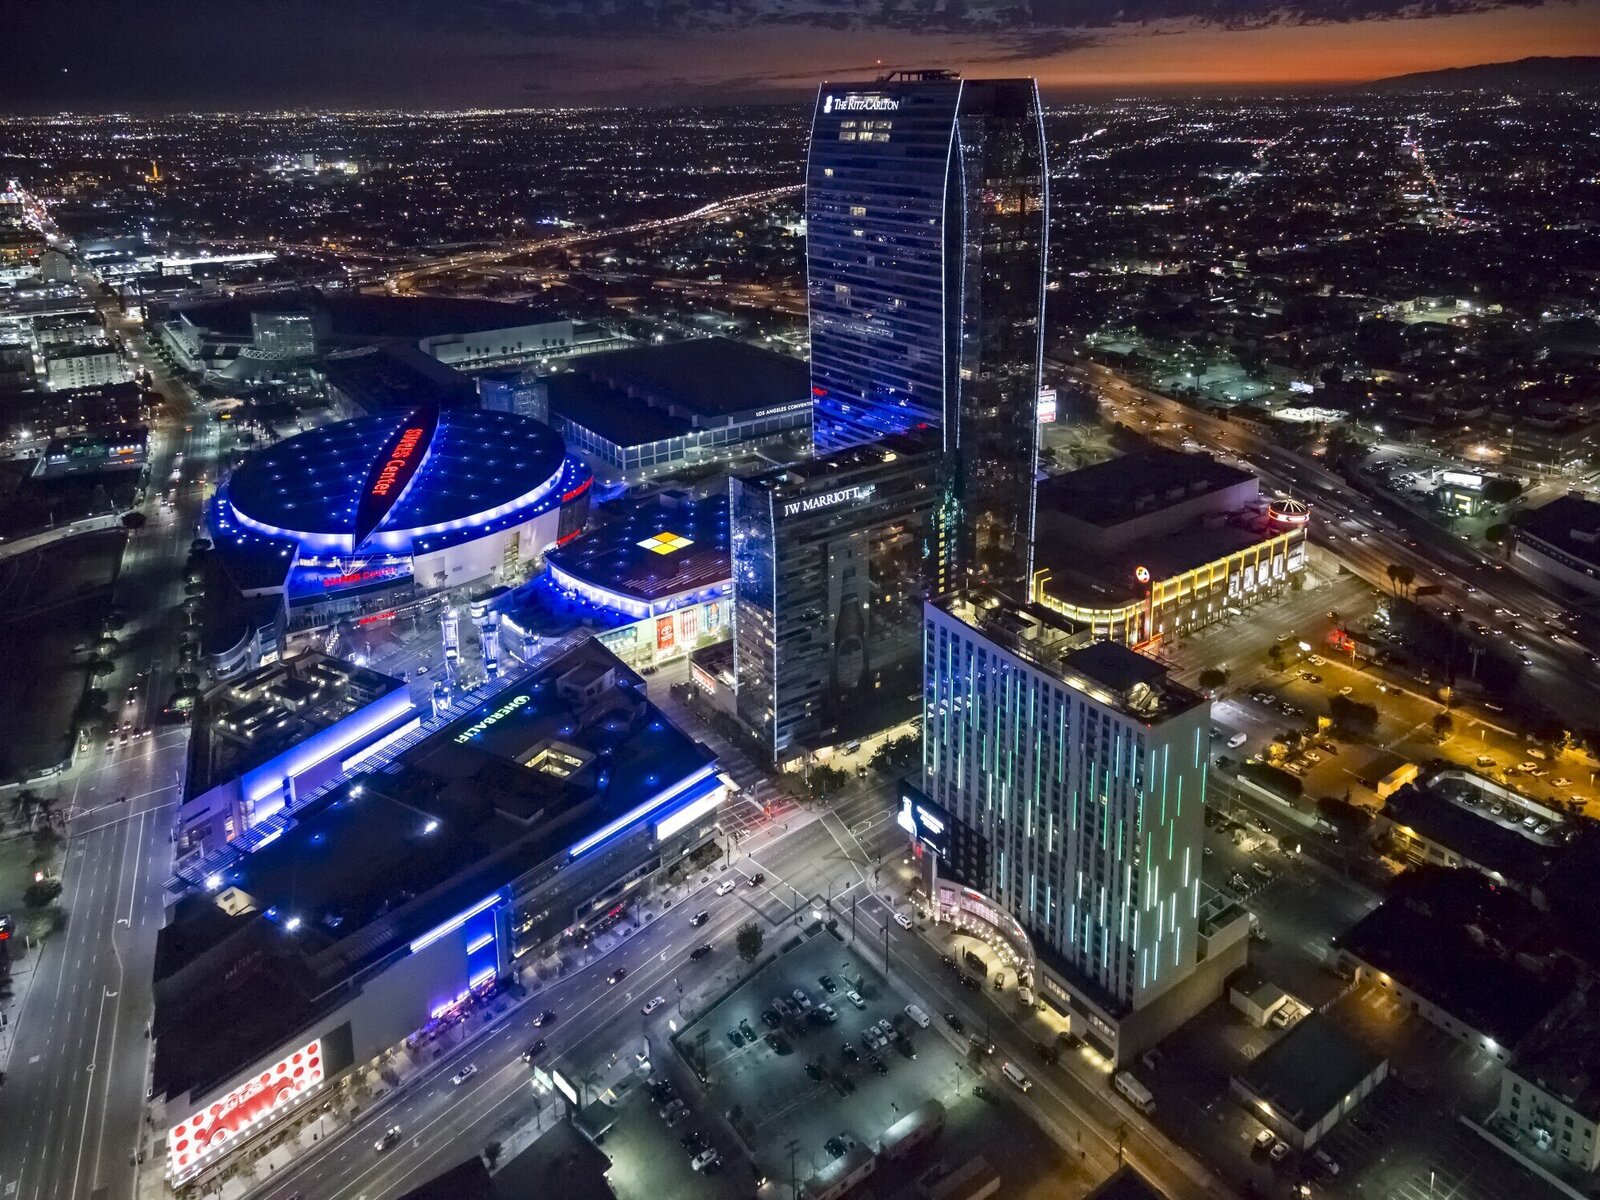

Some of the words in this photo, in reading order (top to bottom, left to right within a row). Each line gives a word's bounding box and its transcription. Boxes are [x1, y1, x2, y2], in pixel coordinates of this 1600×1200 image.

[766, 406, 787, 415] ANGELES
[372, 459, 406, 496] Center
[784, 502, 800, 517] JW
[803, 486, 859, 511] MARRIOTT
